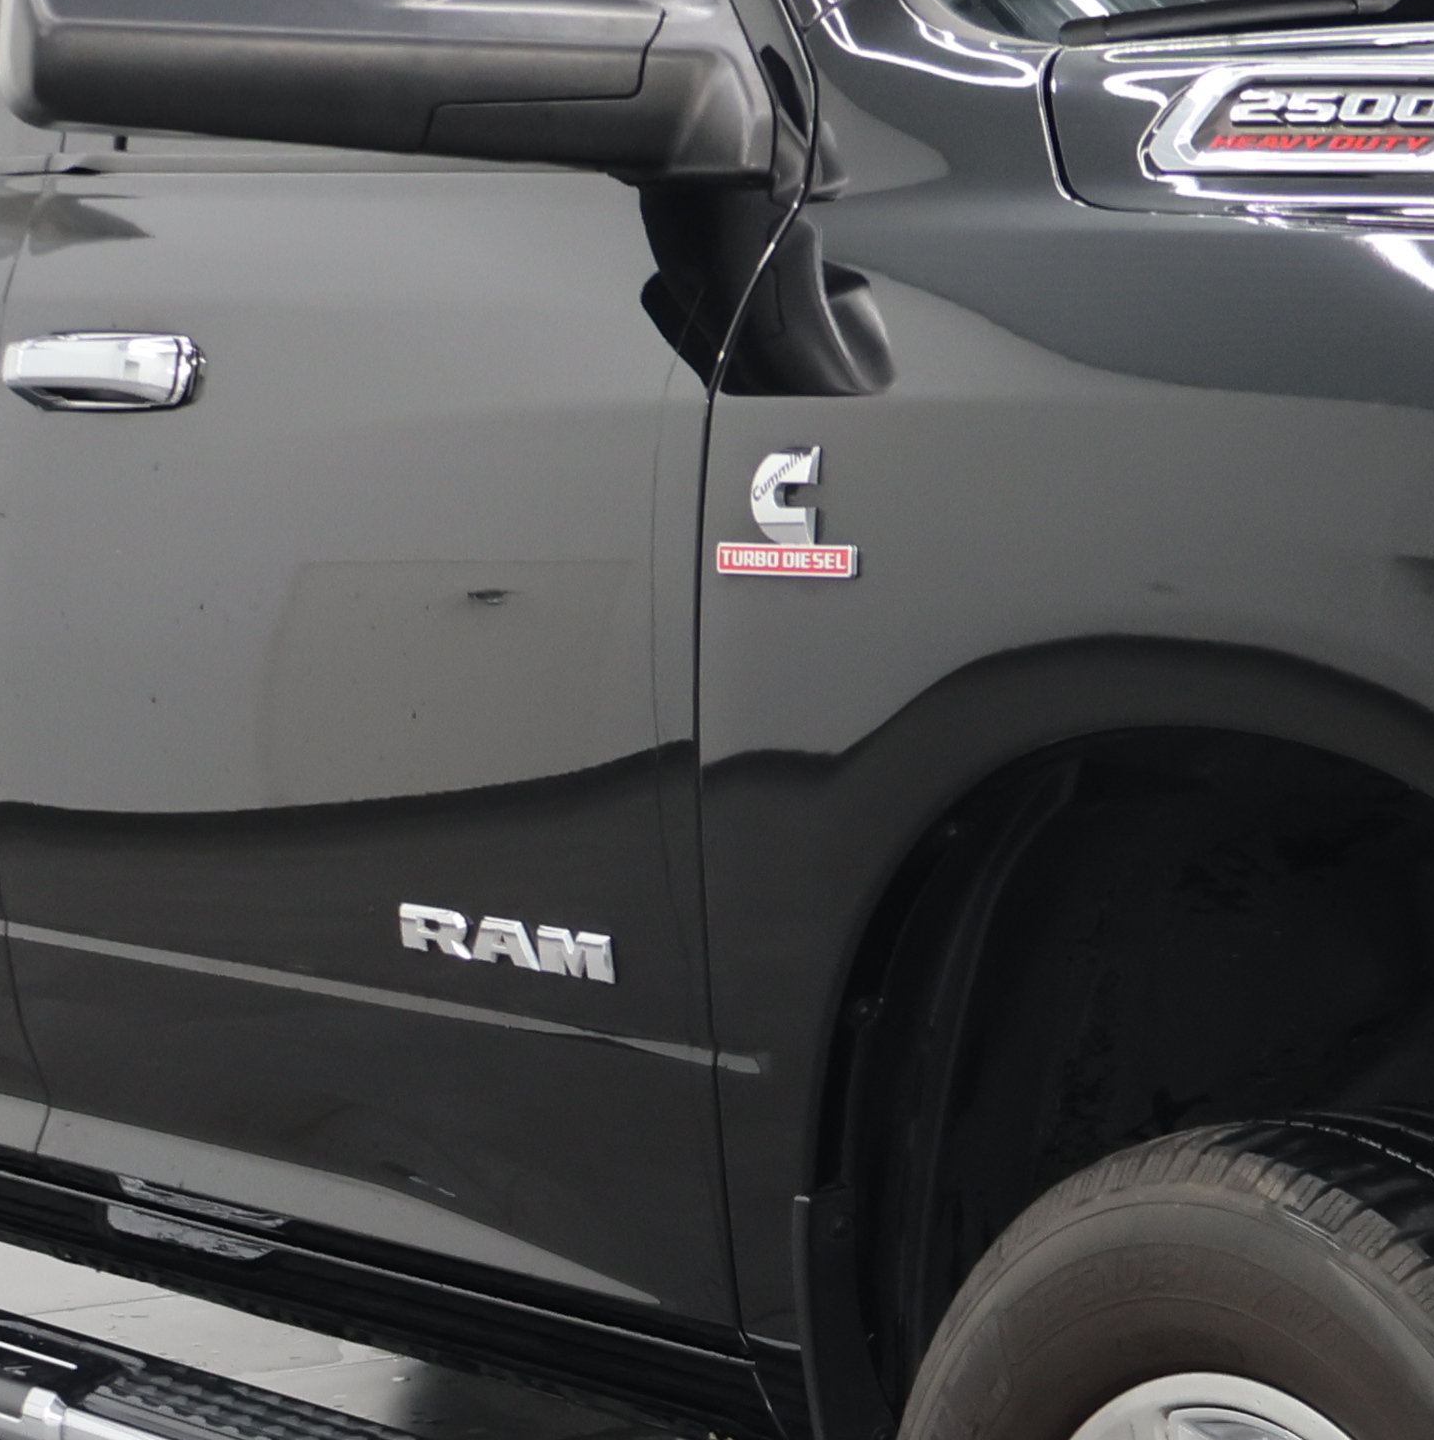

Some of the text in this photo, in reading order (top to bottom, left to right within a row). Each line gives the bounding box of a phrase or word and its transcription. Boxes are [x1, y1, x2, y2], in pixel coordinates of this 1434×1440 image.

[1209, 134, 1432, 152] HEAVY DUTY
[721, 549, 847, 570] TURBO DIESEL
[399, 902, 616, 985] RAM
